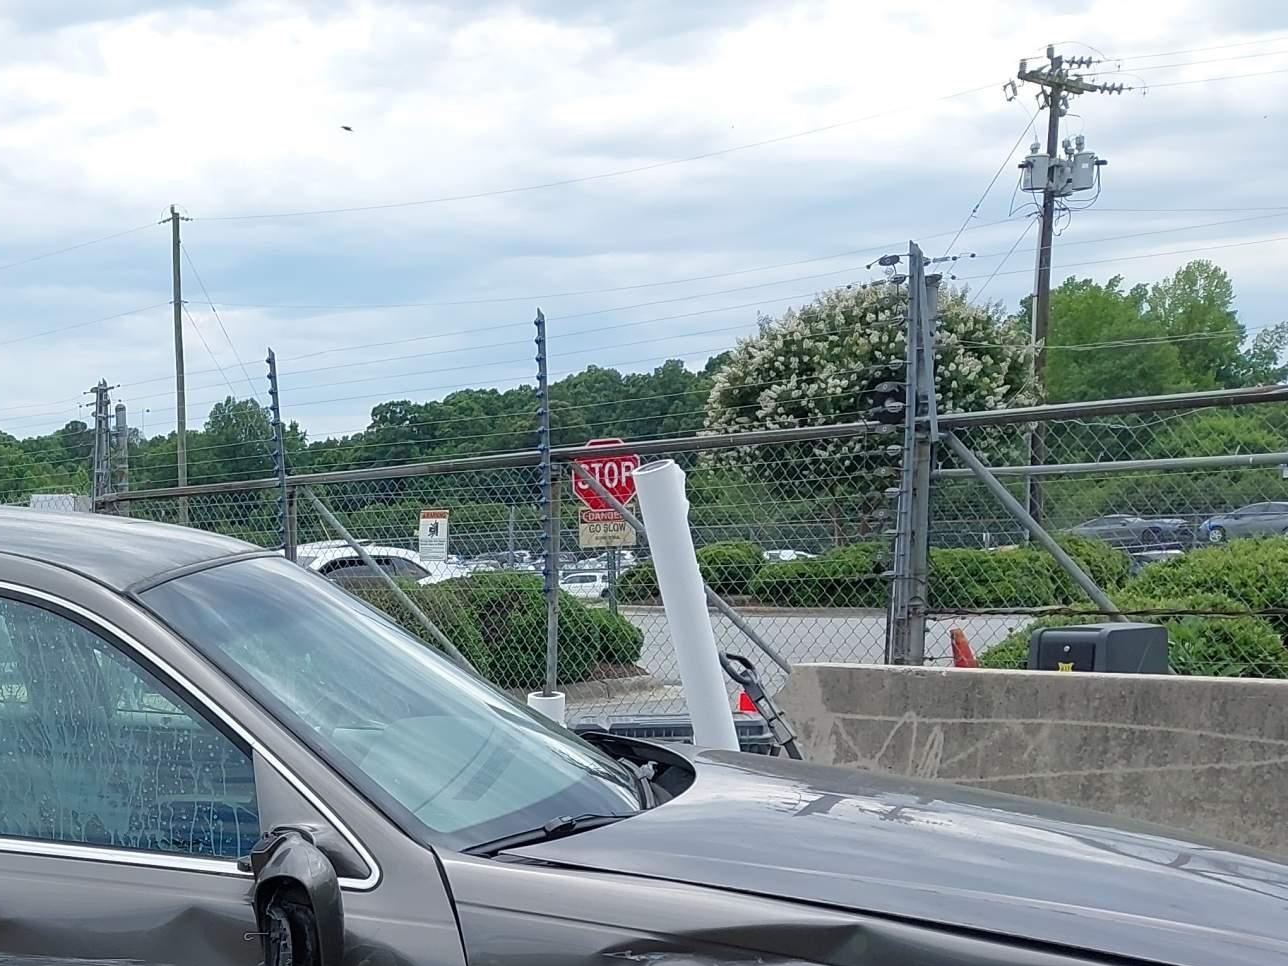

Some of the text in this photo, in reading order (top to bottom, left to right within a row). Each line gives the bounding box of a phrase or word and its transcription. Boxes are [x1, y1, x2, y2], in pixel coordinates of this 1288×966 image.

[588, 511, 623, 521] DANGE
[588, 522, 626, 534] GO SLOW
